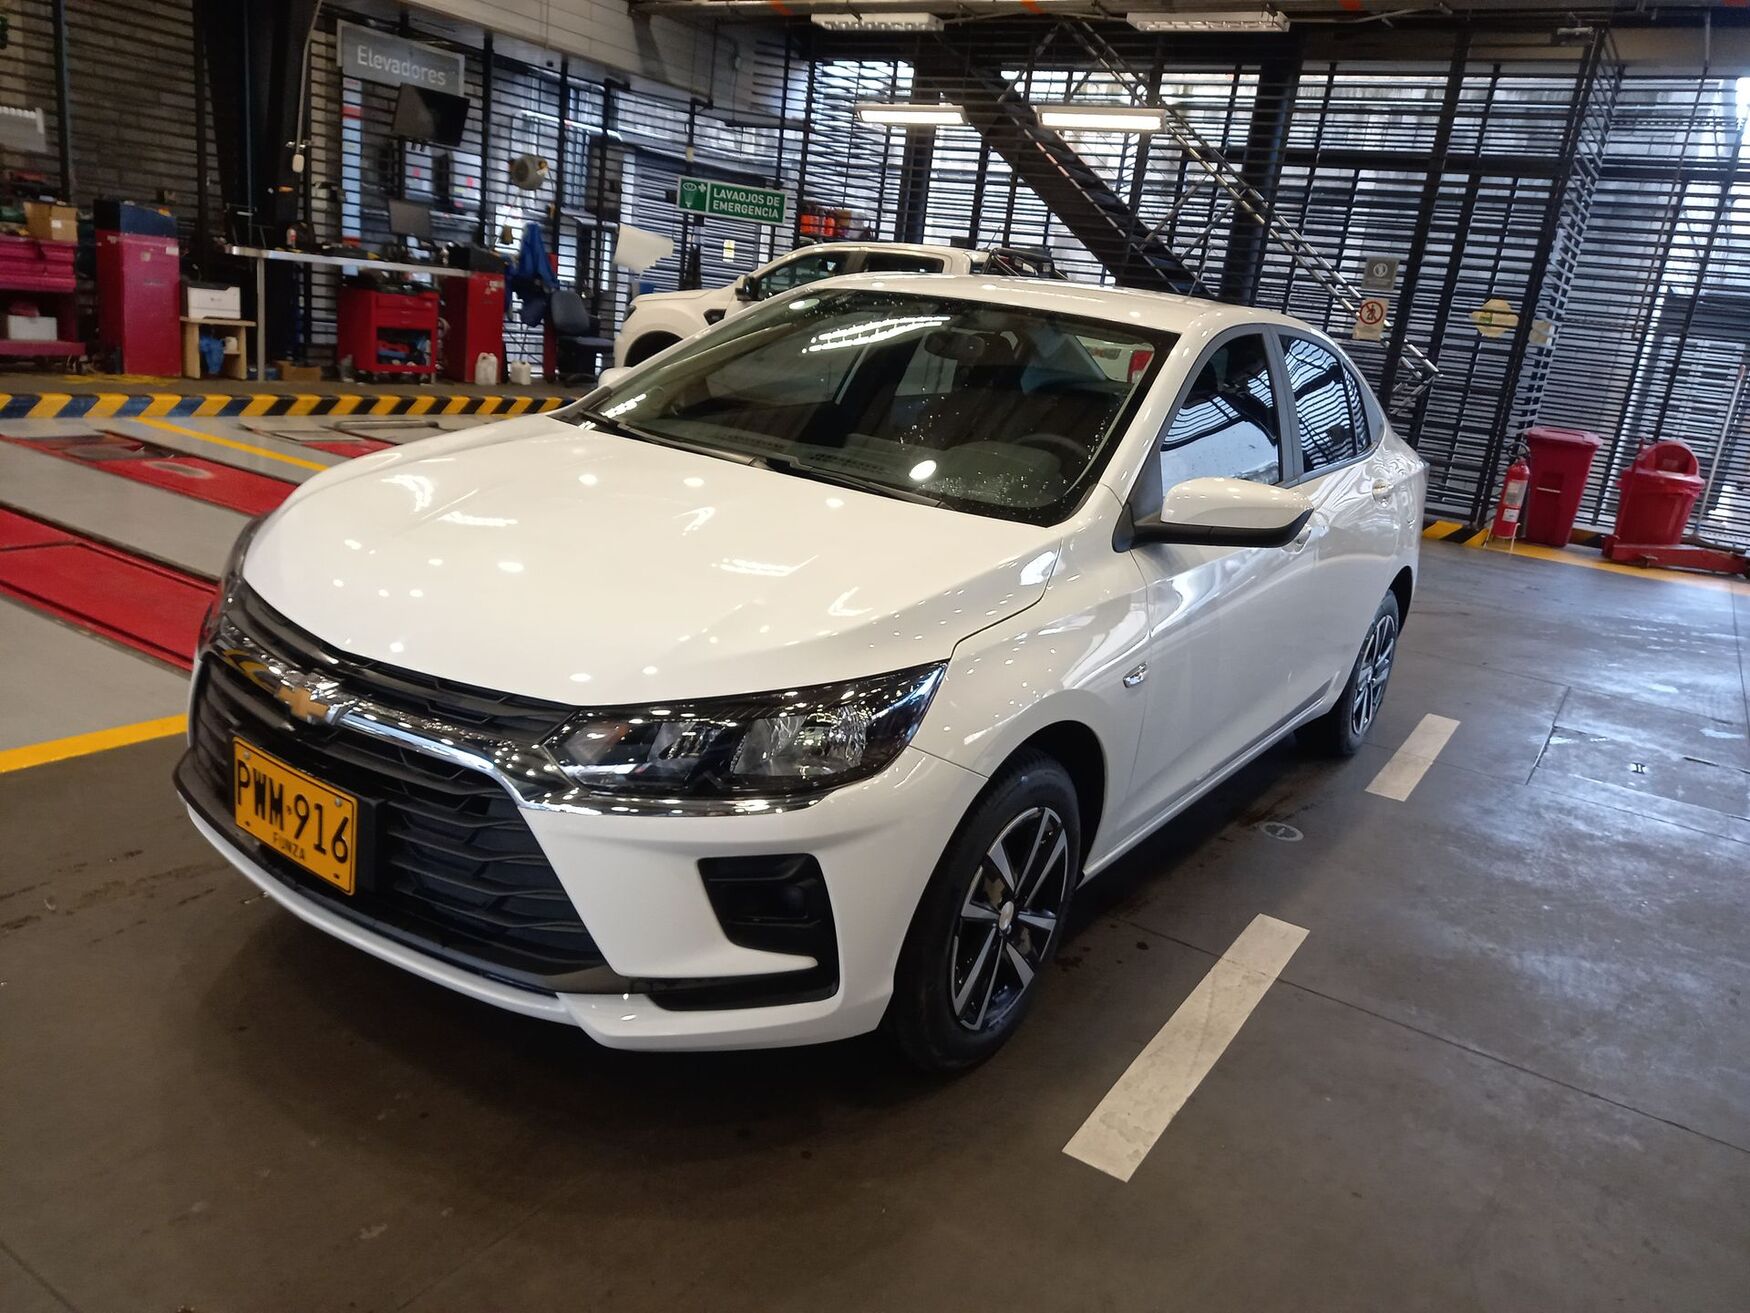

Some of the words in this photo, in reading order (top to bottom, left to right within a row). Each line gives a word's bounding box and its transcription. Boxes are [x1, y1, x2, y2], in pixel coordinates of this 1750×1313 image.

[357, 44, 446, 86] Elevadores
[713, 188, 764, 204] LAVAOJOS
[766, 194, 780, 207] DE
[712, 201, 779, 218] EMERGENCIA
